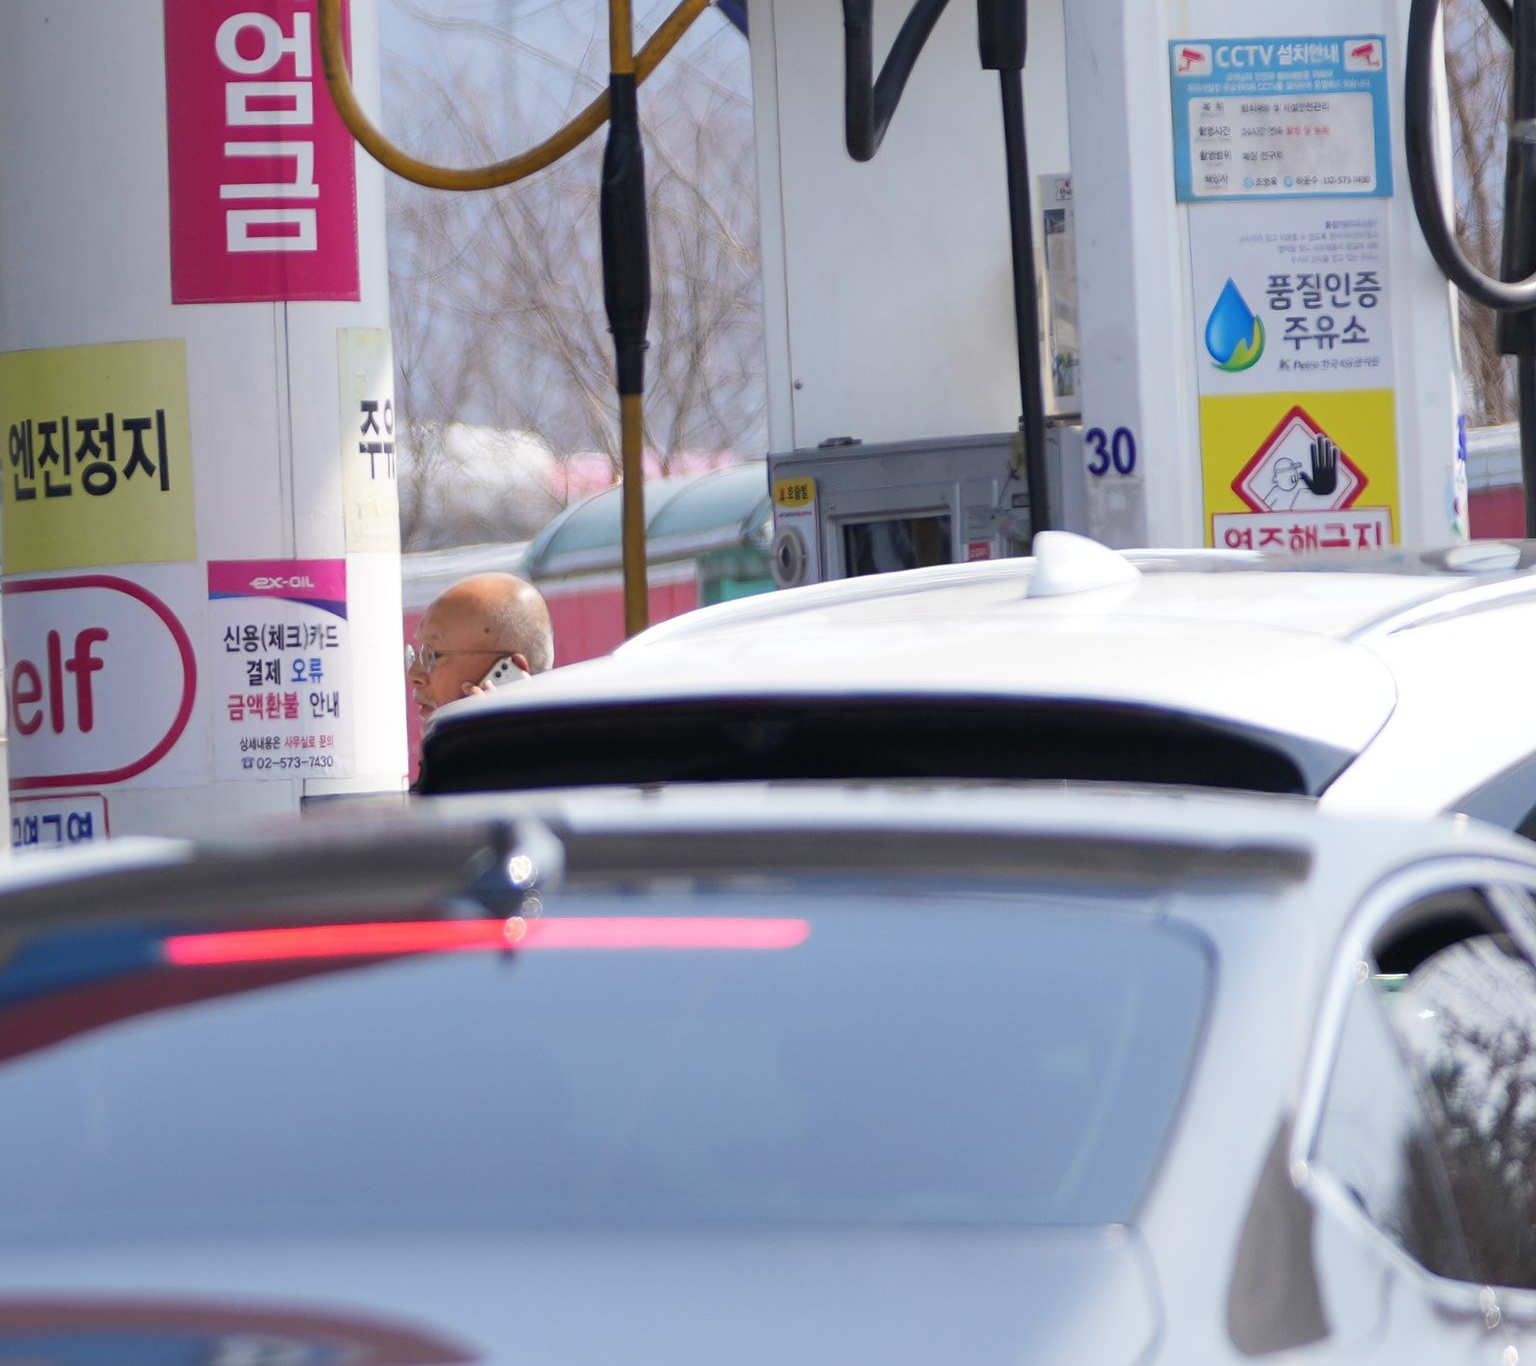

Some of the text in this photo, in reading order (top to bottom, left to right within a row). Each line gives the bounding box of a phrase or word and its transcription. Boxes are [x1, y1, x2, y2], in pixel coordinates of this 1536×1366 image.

[1215, 43, 1339, 67] CCTV 설치안내
[1266, 271, 1382, 311] 품질인증
[1283, 315, 1370, 350] 주유소
[8, 408, 170, 501] 엔진정지
[1085, 426, 1137, 477] 30
[223, 622, 340, 653] 신용(체크)카드
[246, 658, 324, 686] 결제 오류
[227, 691, 340, 721] 금액환불 안내
[239, 736, 281, 752] 상세내용은
[284, 734, 316, 749] 사무실로
[256, 755, 334, 770] 02-573-7430
